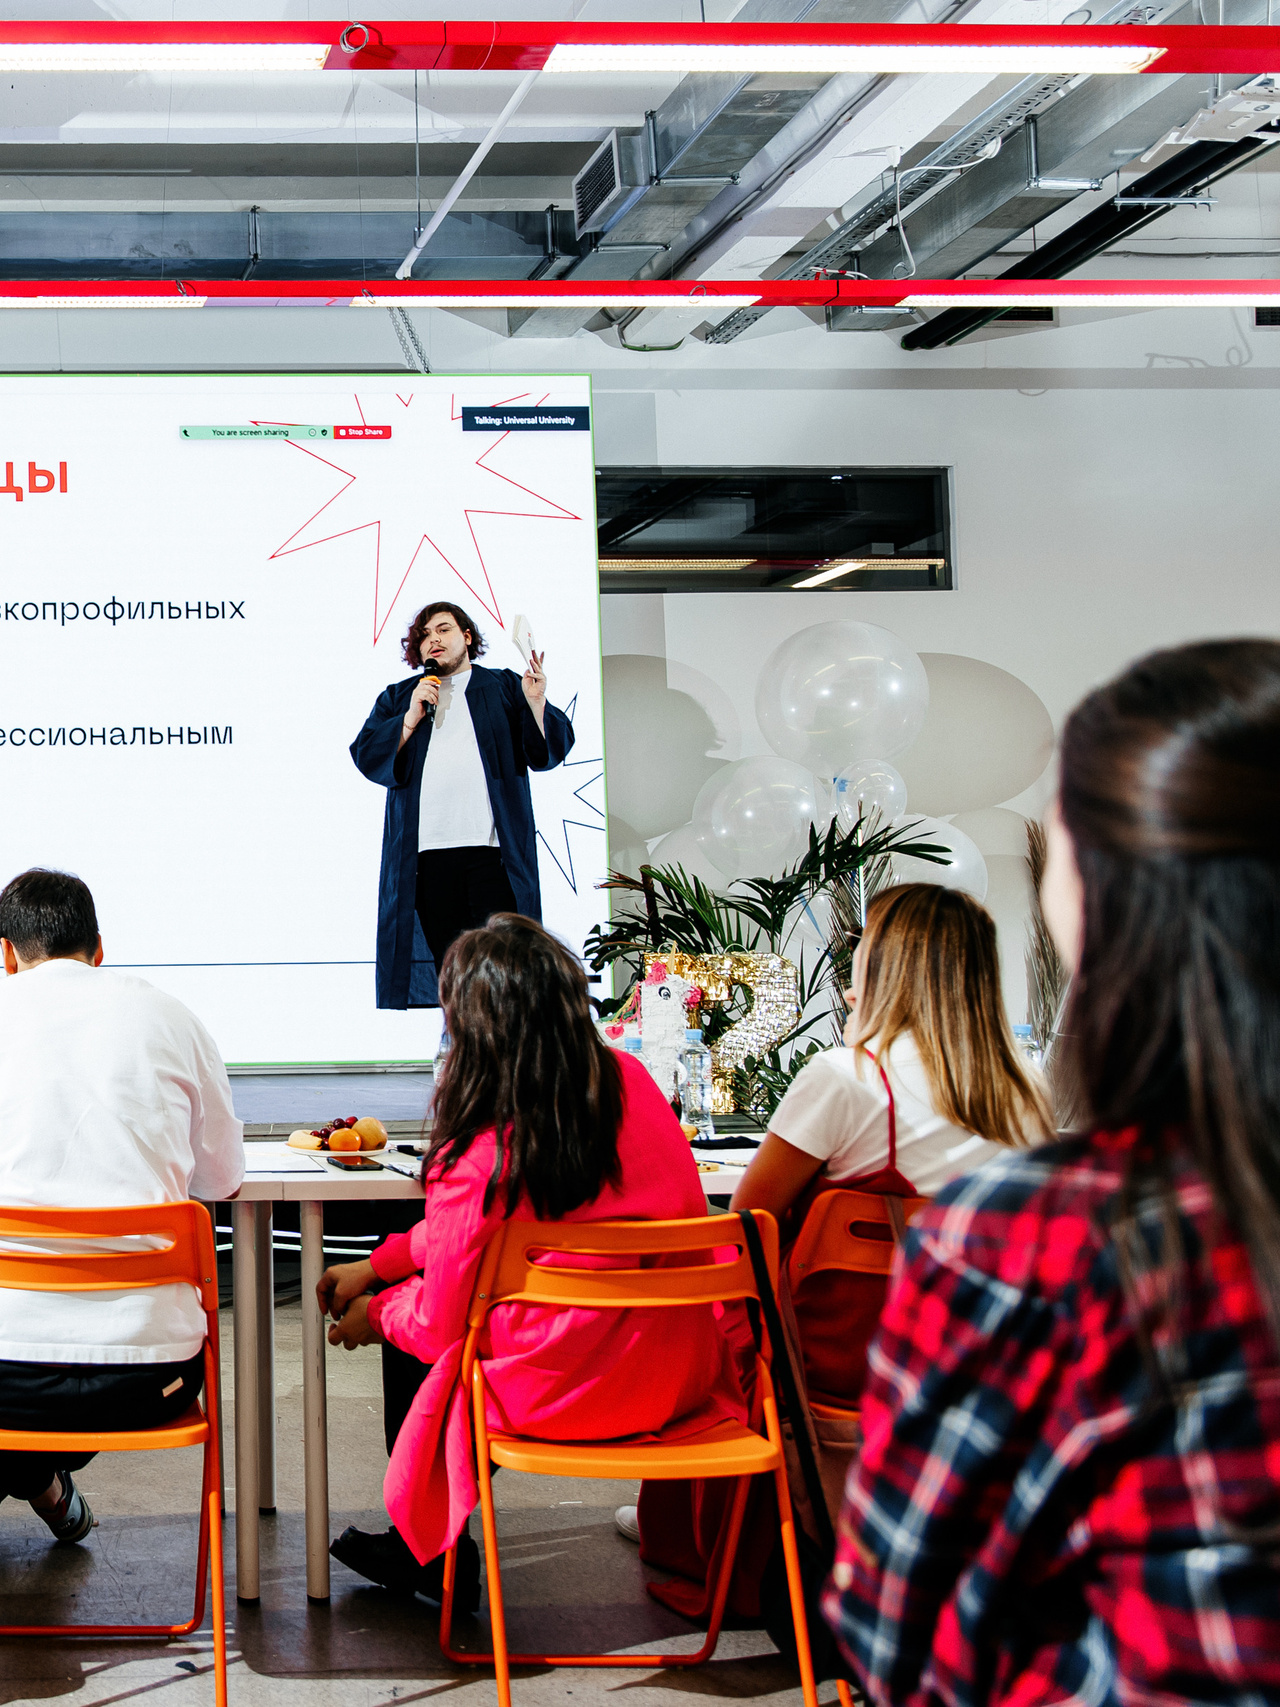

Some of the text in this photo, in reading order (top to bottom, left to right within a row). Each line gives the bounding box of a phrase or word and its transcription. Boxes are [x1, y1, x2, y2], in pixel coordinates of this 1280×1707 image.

[473, 415, 576, 427] Talking: Universal University
[212, 429, 226, 437] You
[263, 428, 290, 438] sharing
[348, 428, 384, 437] Stop Share
